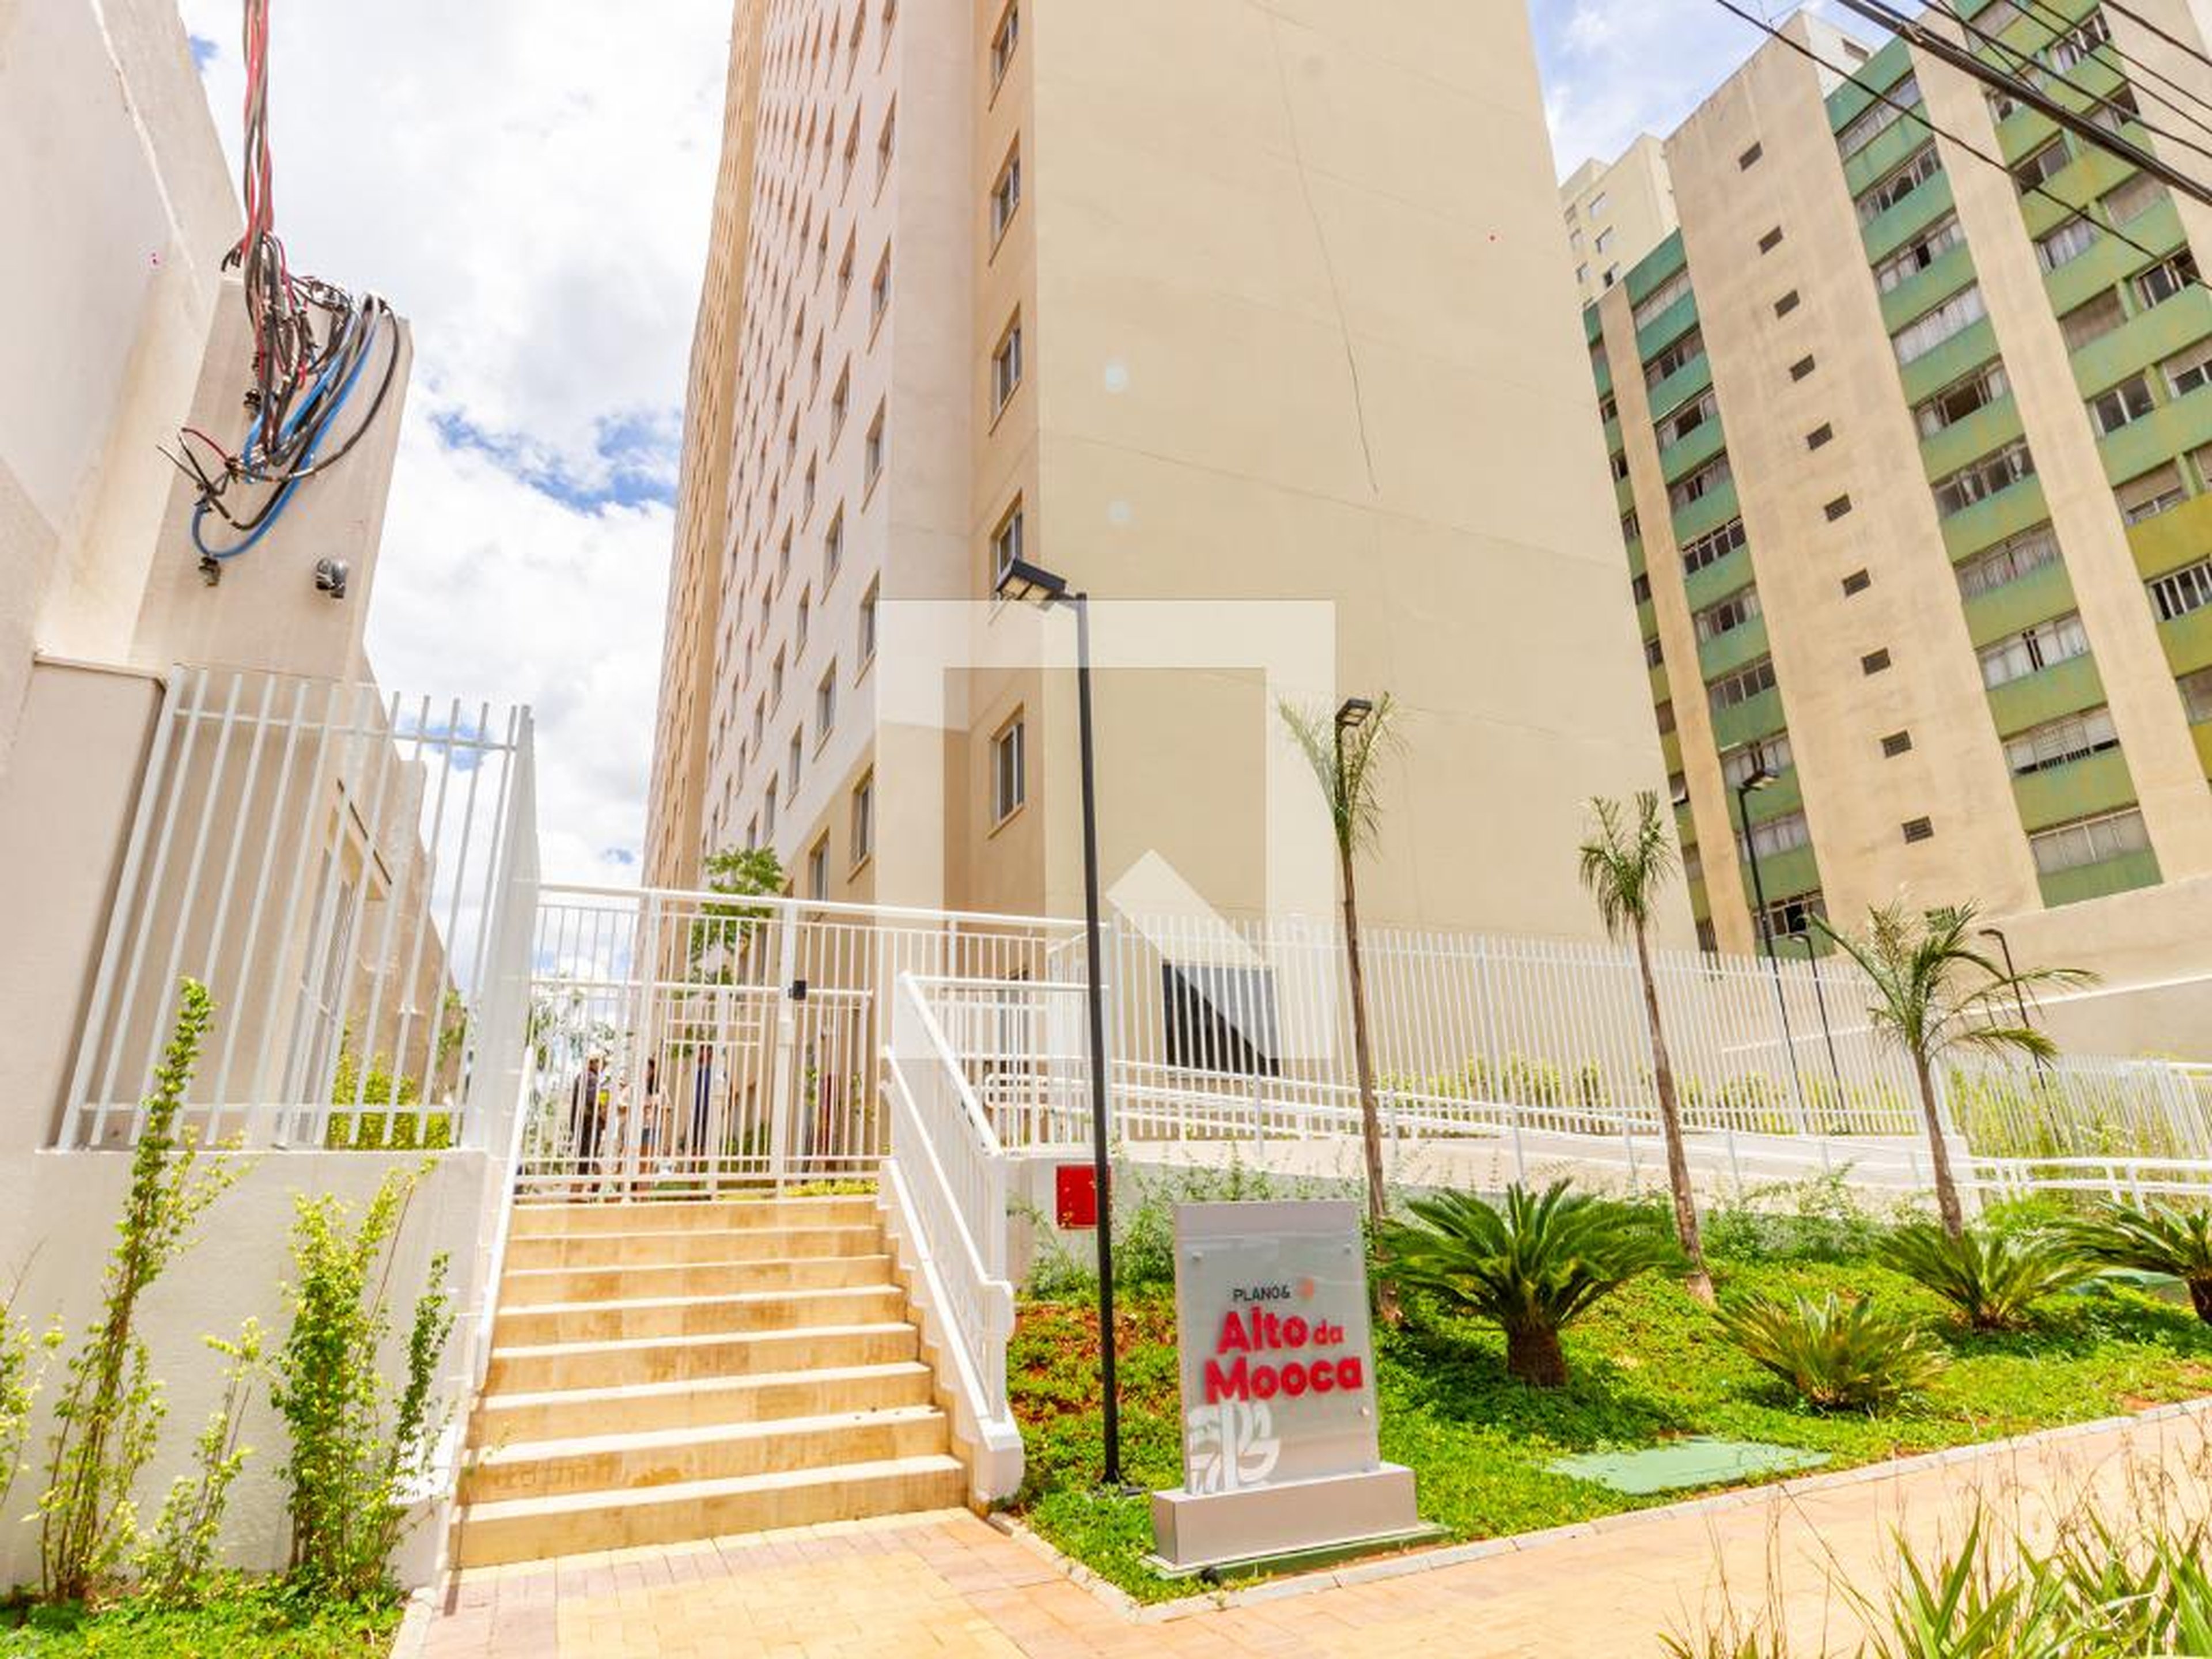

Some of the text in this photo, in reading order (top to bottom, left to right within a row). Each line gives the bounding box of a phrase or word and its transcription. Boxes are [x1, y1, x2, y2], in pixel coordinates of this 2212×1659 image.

[1217, 1306, 1344, 1354] Alto da
[1205, 1355, 1363, 1405] Mooca
